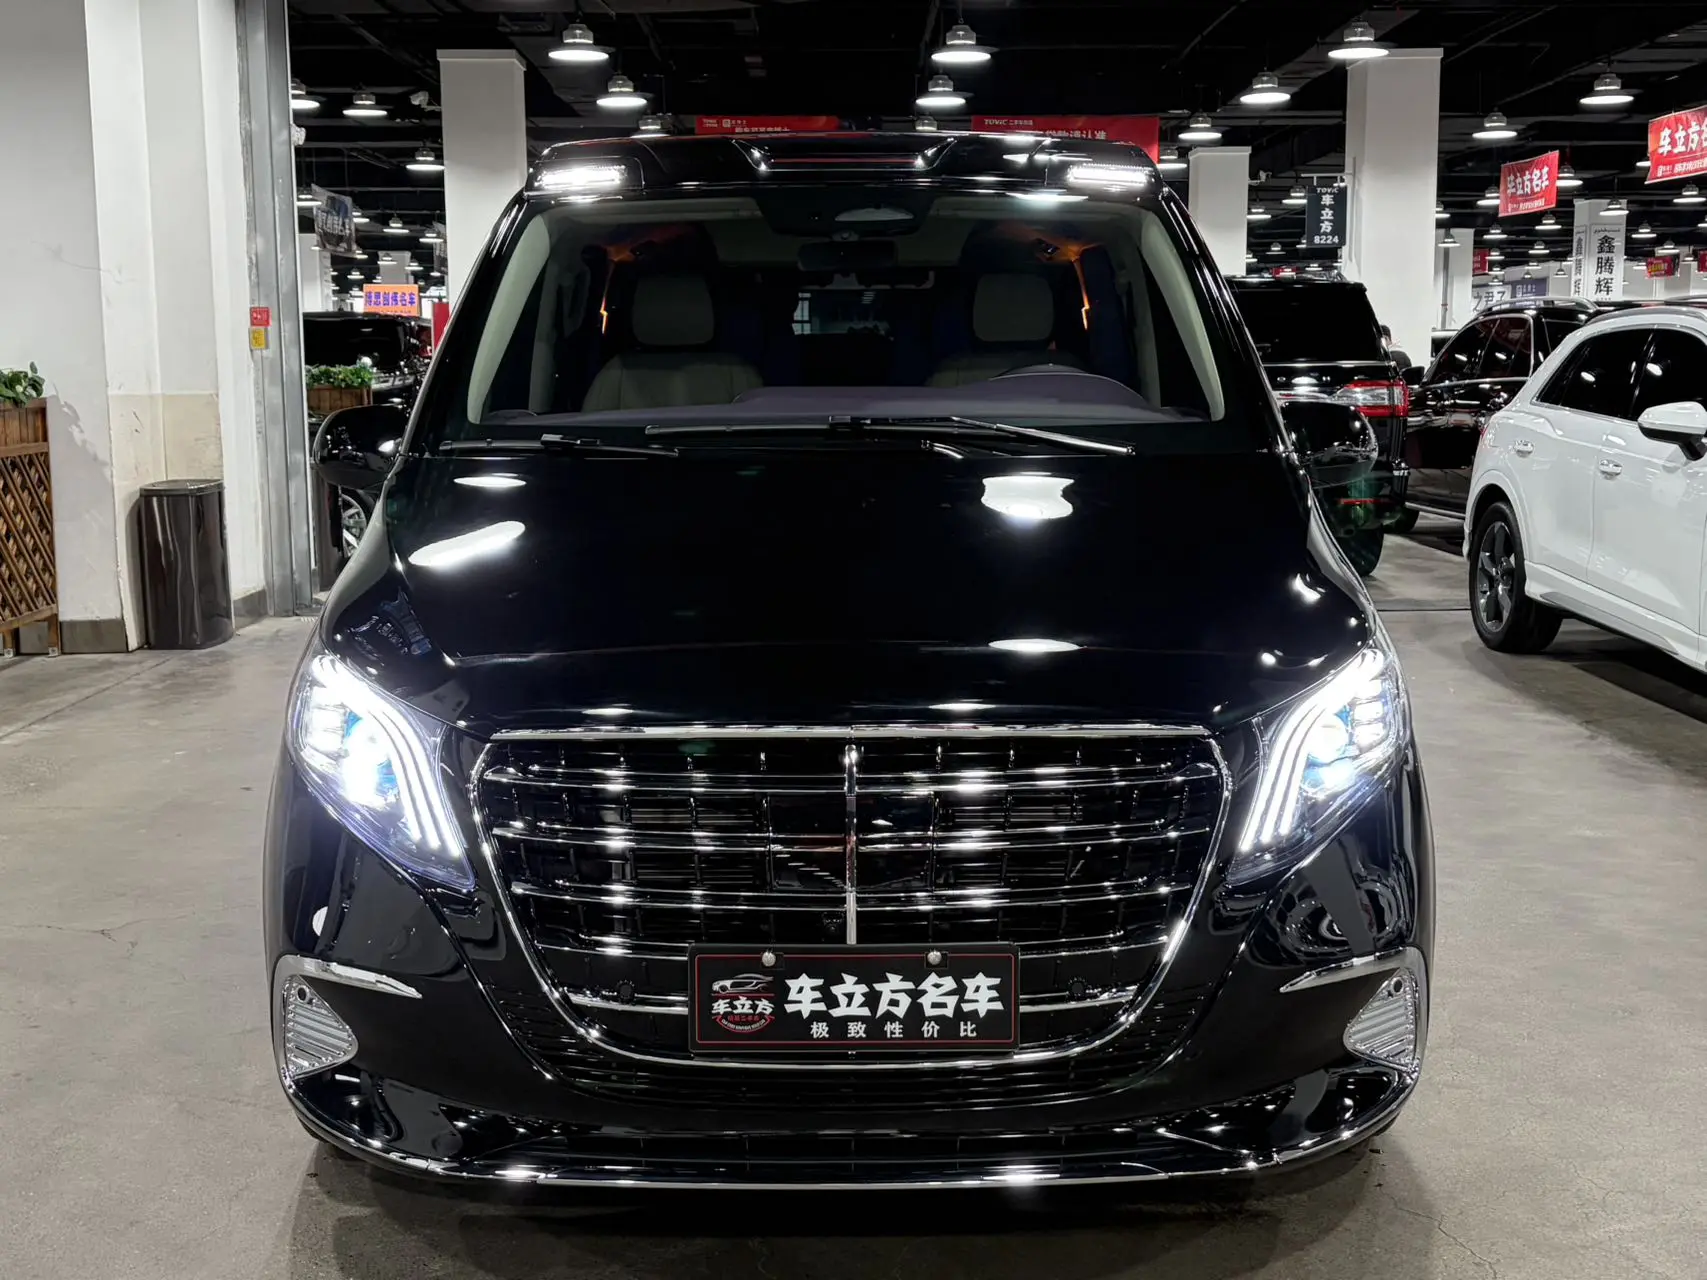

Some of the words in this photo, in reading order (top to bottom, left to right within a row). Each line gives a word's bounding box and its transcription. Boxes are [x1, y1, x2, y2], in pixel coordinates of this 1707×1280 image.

[1507, 165, 1550, 196] 车立方名车
[1319, 194, 1335, 233] 车立方
[1313, 235, 1339, 244] 8224
[1594, 234, 1615, 296] 鑫腾辉
[711, 995, 775, 1015] 车立方
[783, 971, 1005, 1020] 车立方名车
[811, 1020, 978, 1039] 极致性价比
